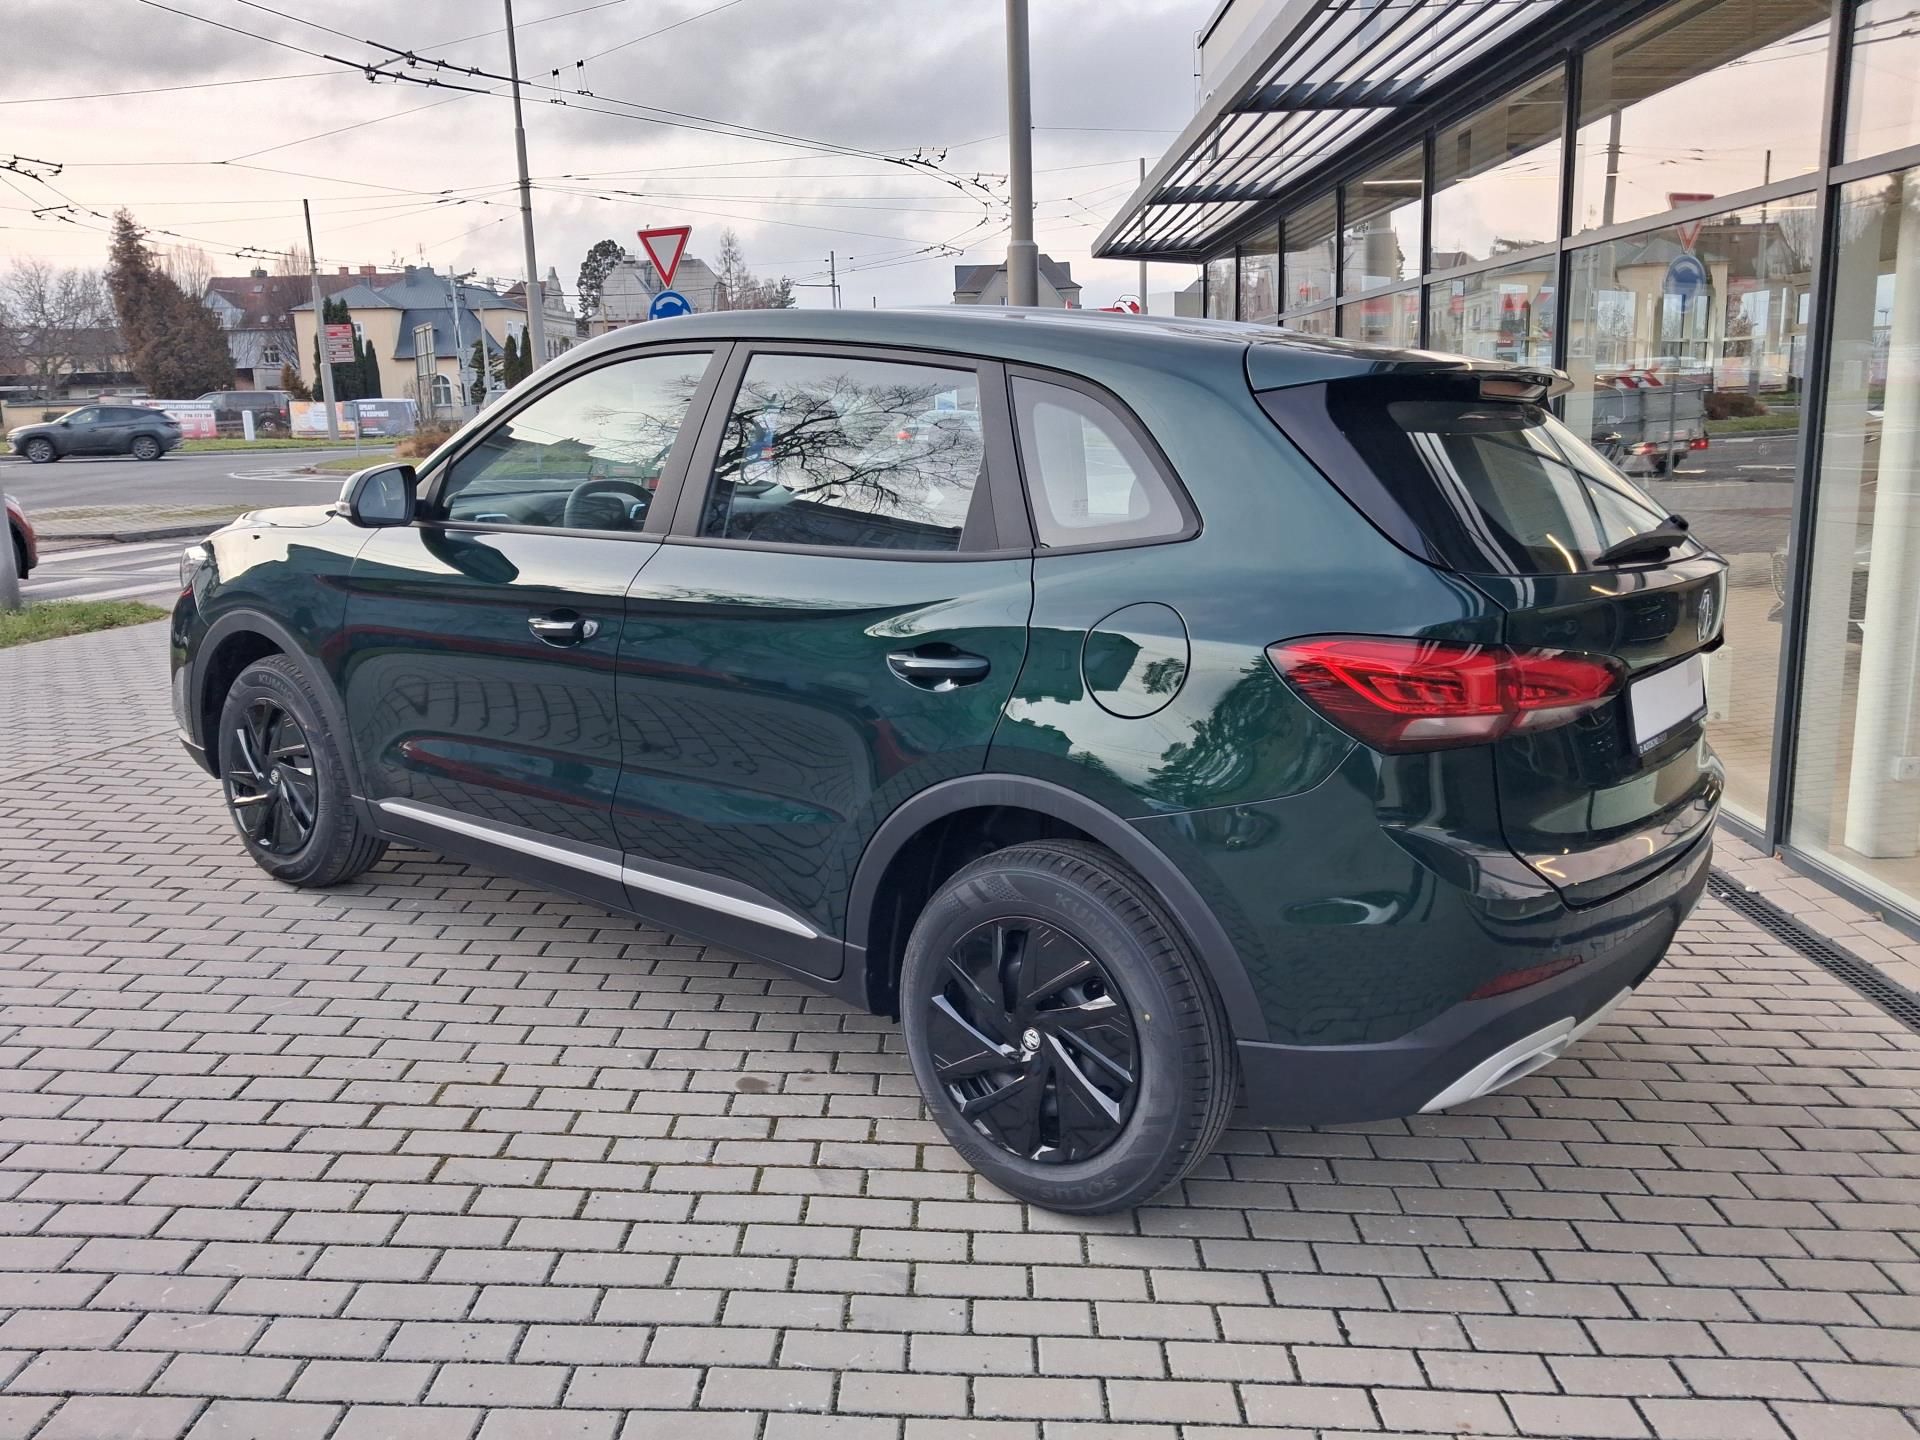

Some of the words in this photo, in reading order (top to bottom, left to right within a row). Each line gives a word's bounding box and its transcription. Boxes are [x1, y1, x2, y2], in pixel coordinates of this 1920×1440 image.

[258, 674, 294, 701] KUMHO
[1055, 888, 1134, 967] KUMHO
[1038, 1174, 1117, 1199] SOLUS
